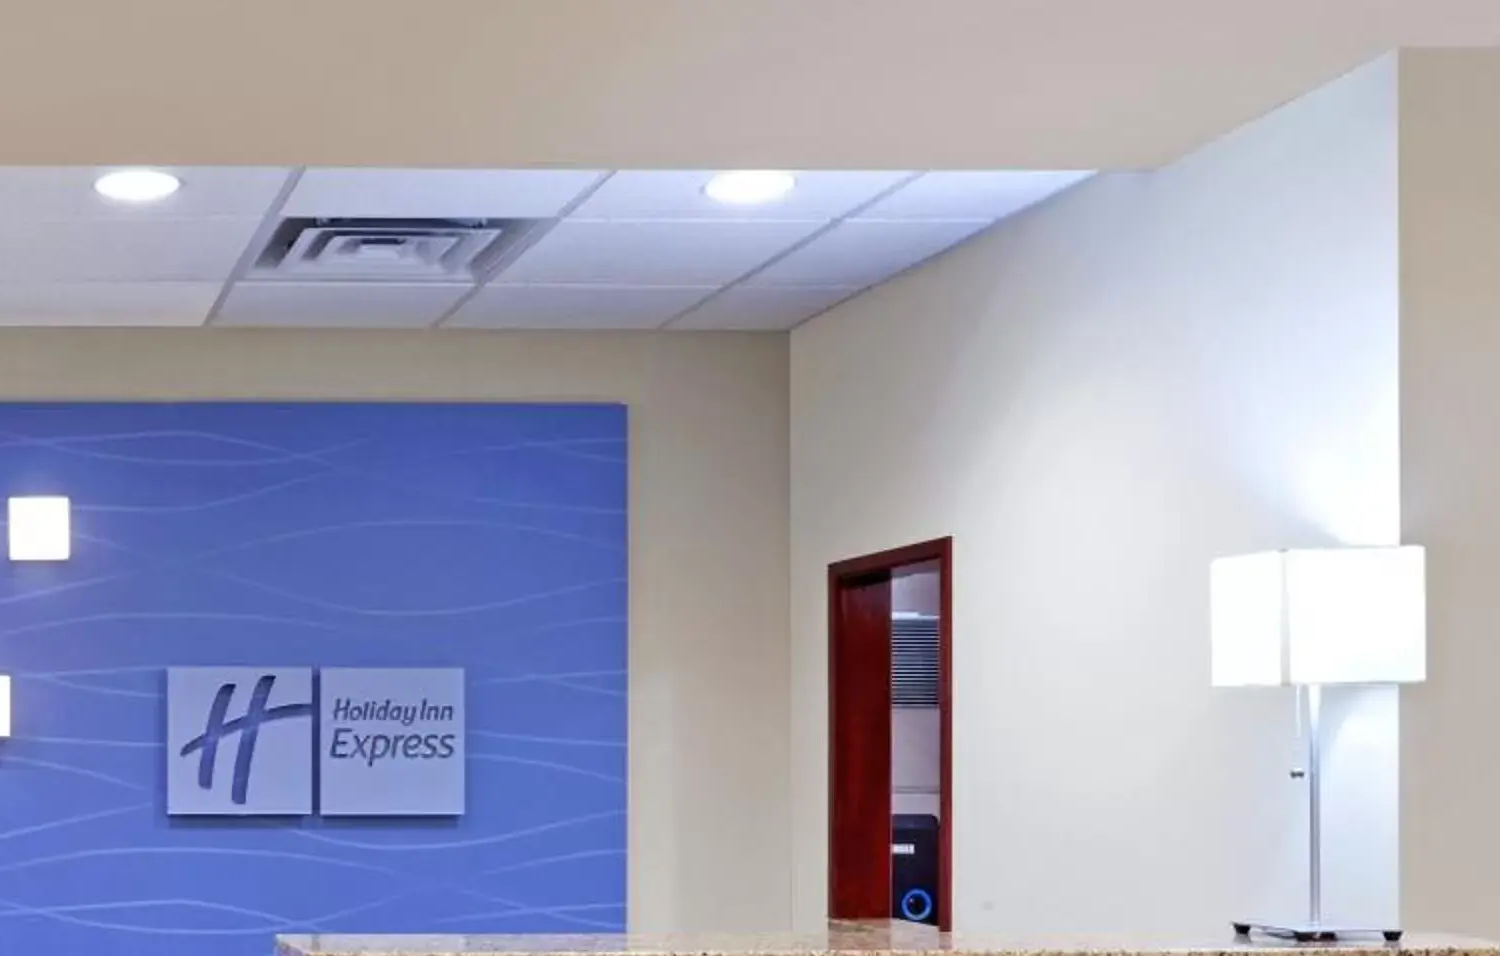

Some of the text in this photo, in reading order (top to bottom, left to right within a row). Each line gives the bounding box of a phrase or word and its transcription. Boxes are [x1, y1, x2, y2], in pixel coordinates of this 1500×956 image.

[332, 697, 454, 726] Holiday Inn
[329, 727, 456, 768] Express
